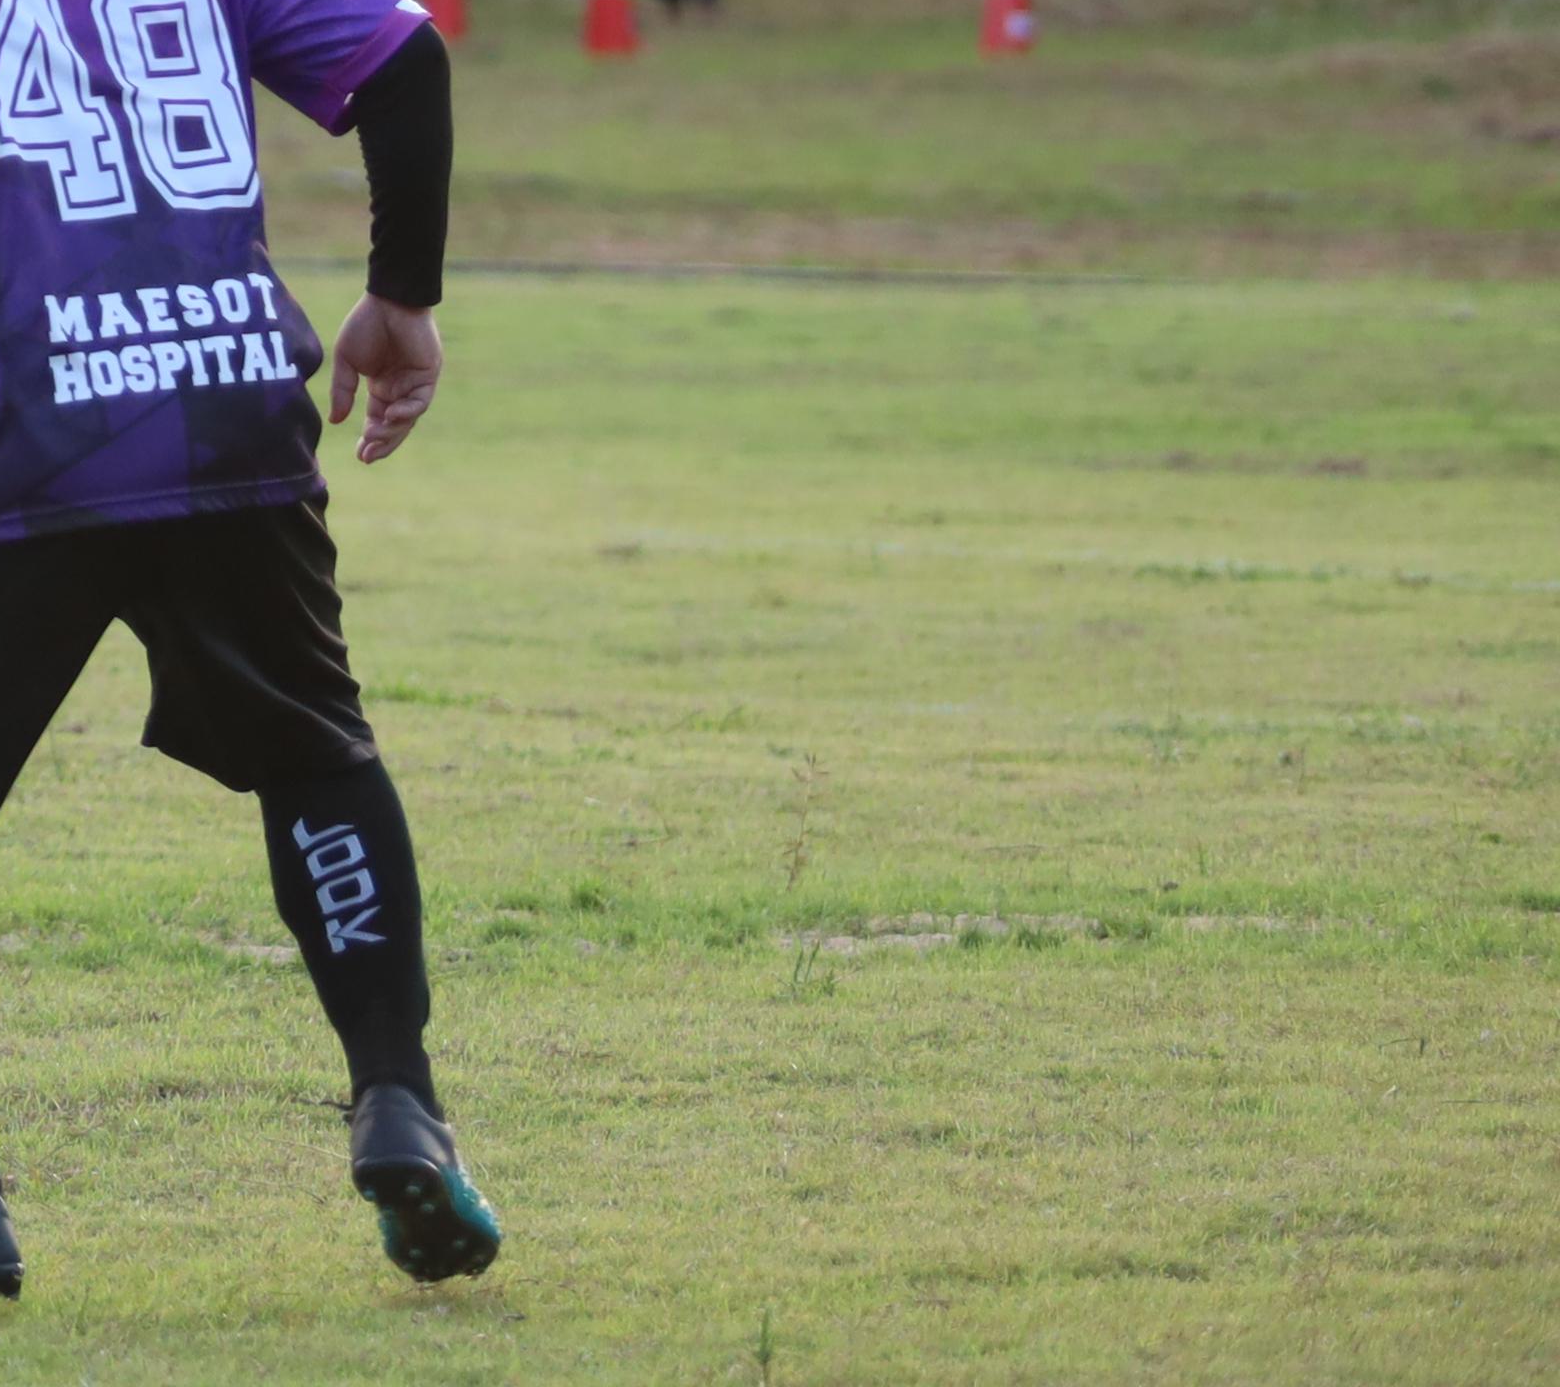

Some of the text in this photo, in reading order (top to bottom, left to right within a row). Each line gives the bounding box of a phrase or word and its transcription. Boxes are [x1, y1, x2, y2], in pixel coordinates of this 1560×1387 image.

[43, 271, 277, 343] MAESOT
[51, 331, 298, 405] HOSPITAL
[290, 816, 387, 955] JOOK
